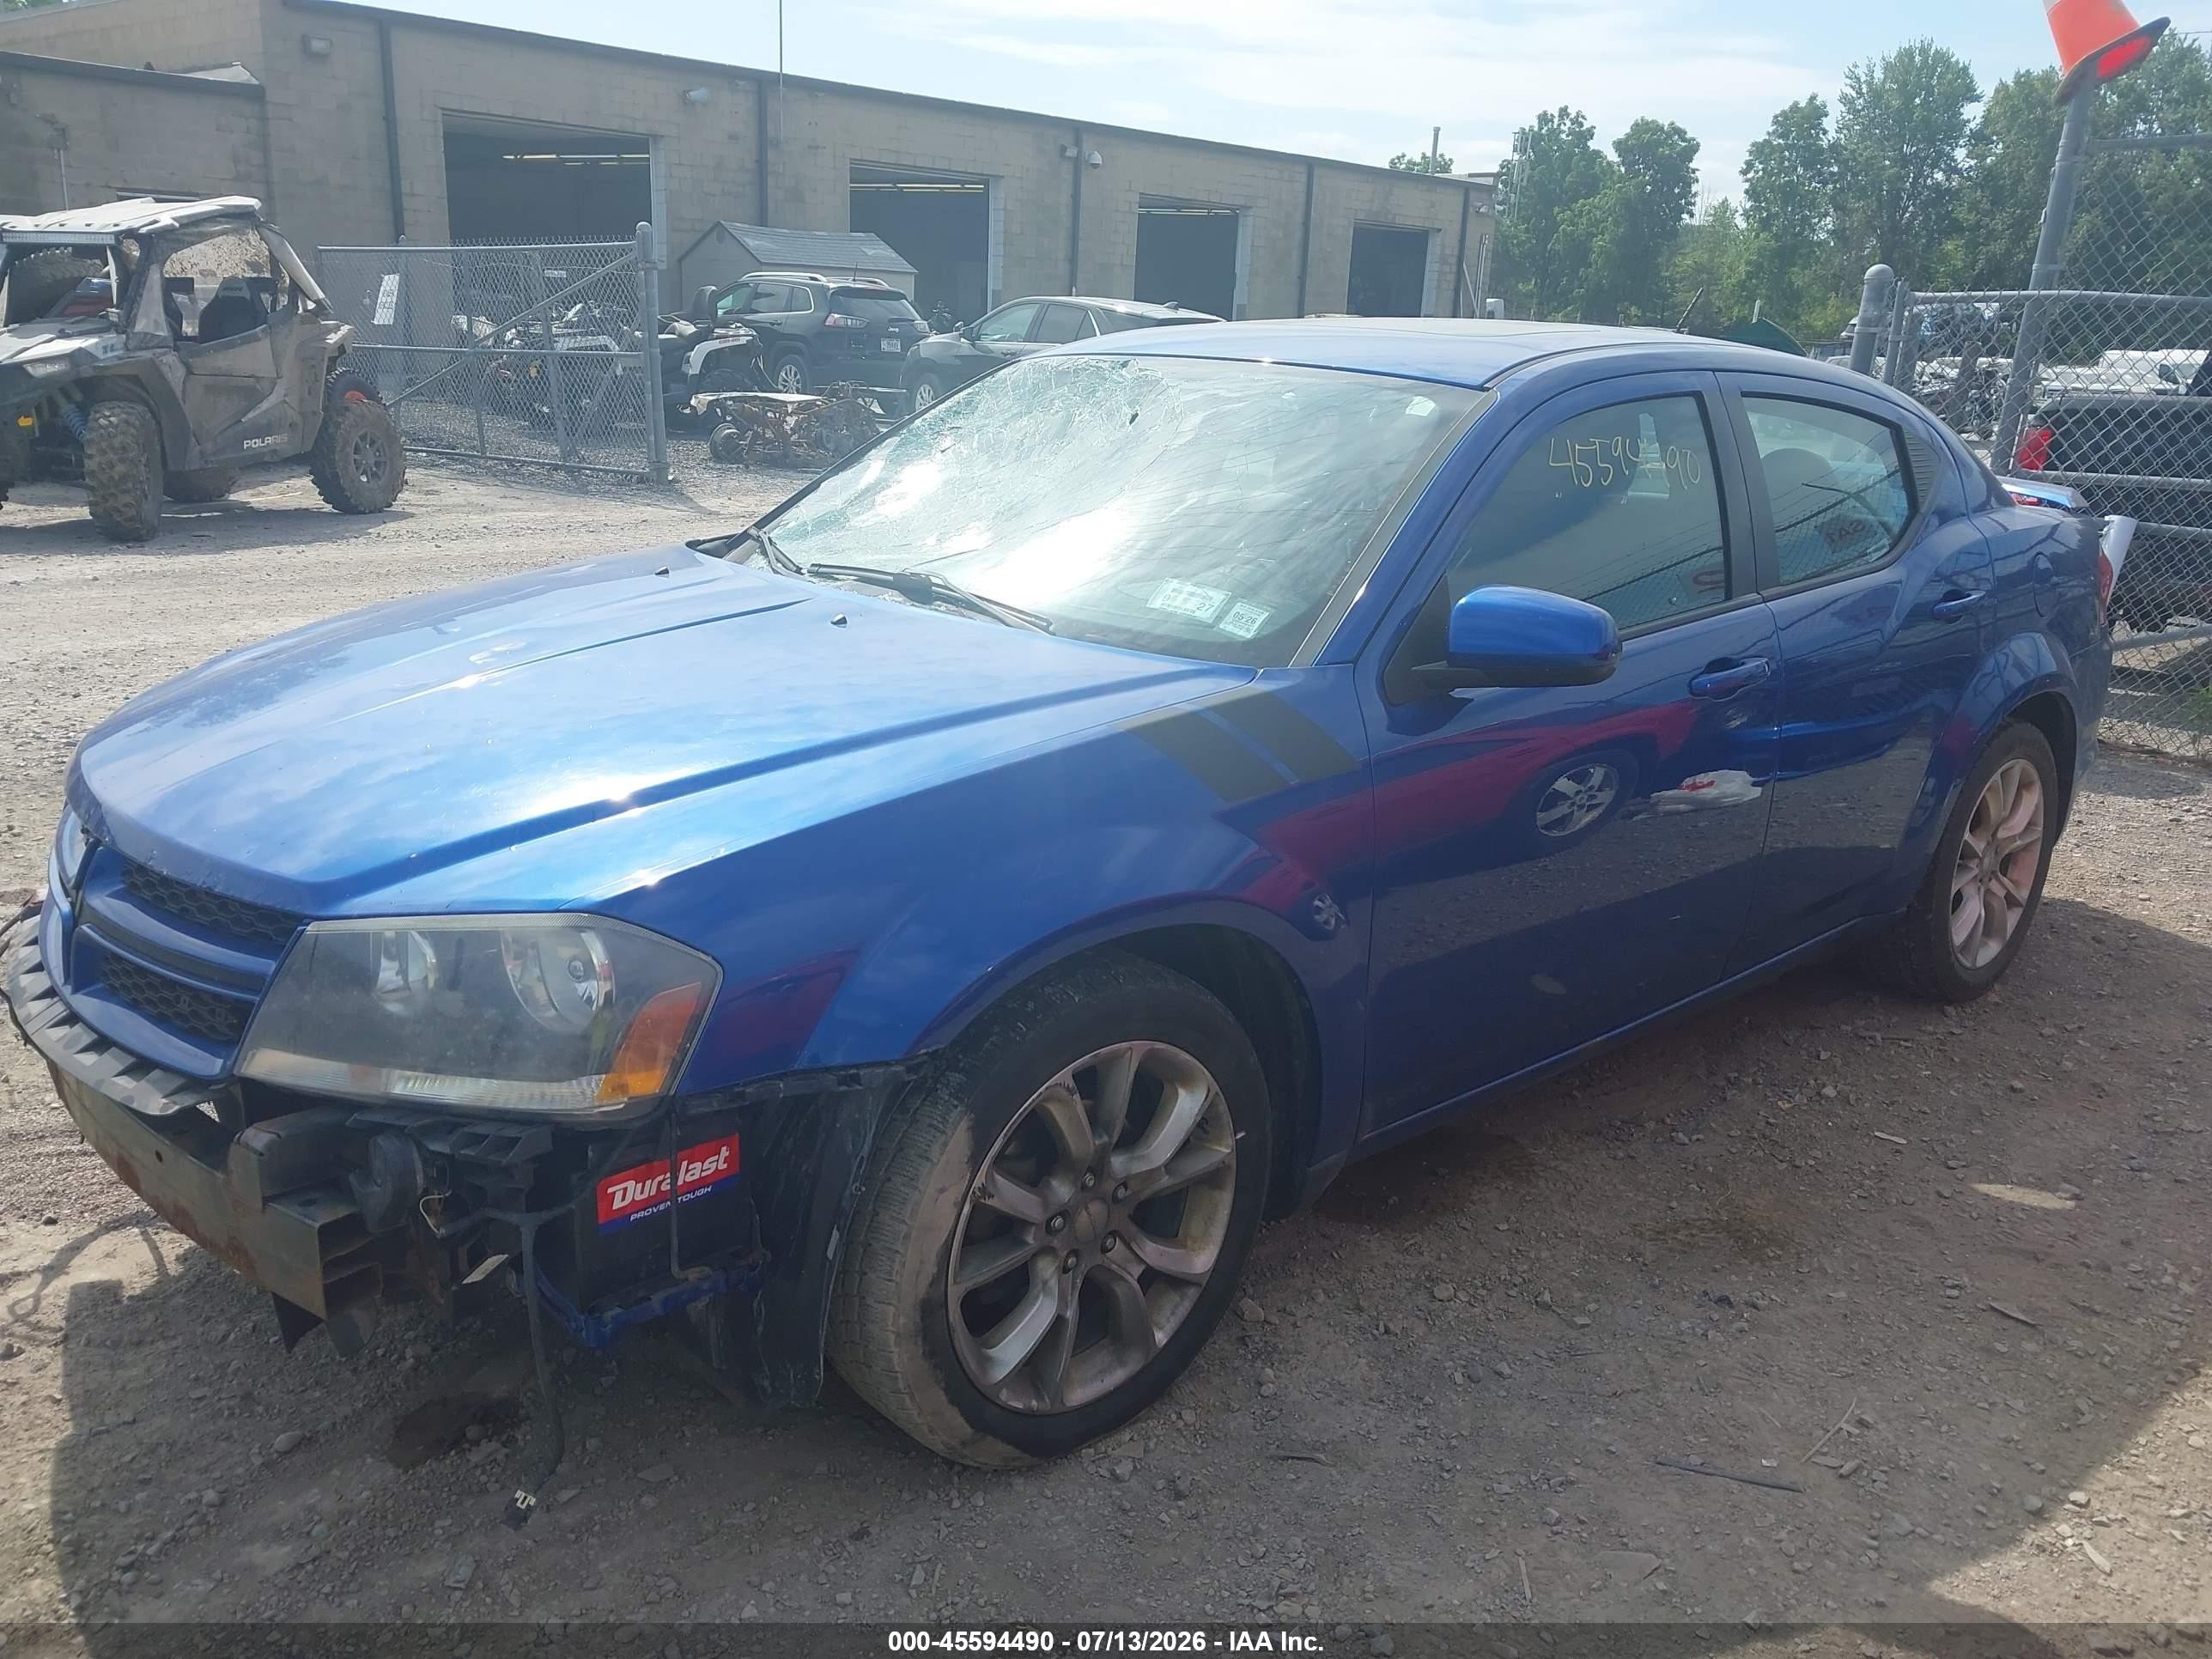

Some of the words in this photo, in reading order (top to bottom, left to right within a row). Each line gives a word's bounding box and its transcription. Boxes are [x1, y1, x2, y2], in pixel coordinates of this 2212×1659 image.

[244, 433, 289, 450] POLARIS
[1196, 602, 1215, 612] 27
[606, 1146, 730, 1210] Duralast
[677, 1185, 713, 1204] TOUGH
